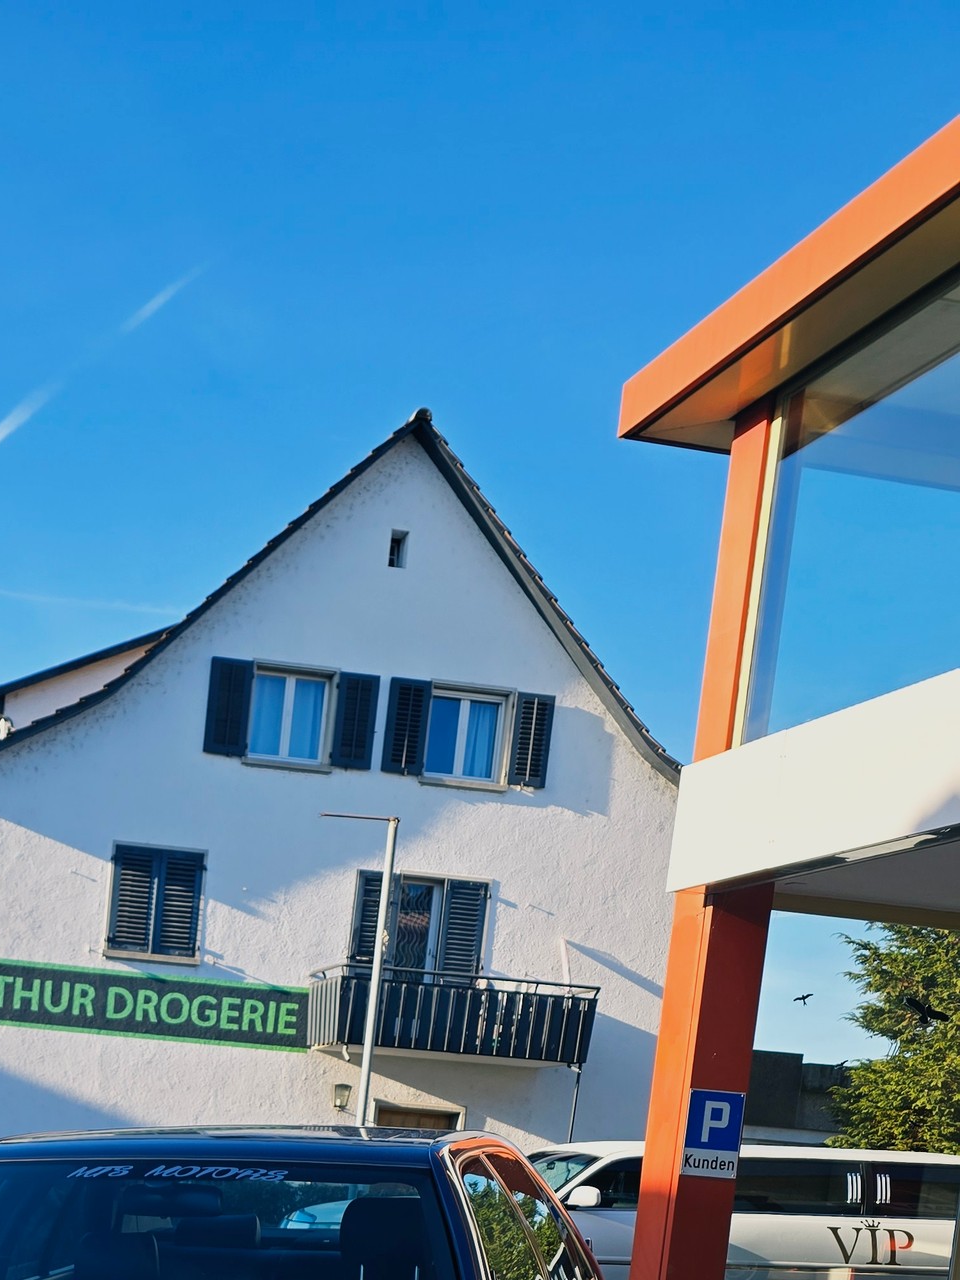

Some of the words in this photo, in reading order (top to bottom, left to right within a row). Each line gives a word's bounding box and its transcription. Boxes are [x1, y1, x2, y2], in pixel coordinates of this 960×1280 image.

[106, 986, 299, 1035] DROGERIE
[700, 1100, 731, 1142] P
[67, 1164, 134, 1179] MTS
[144, 1164, 290, 1183] MOTORS
[683, 1153, 735, 1172] Kunden
[826, 1226, 915, 1266] VIP
